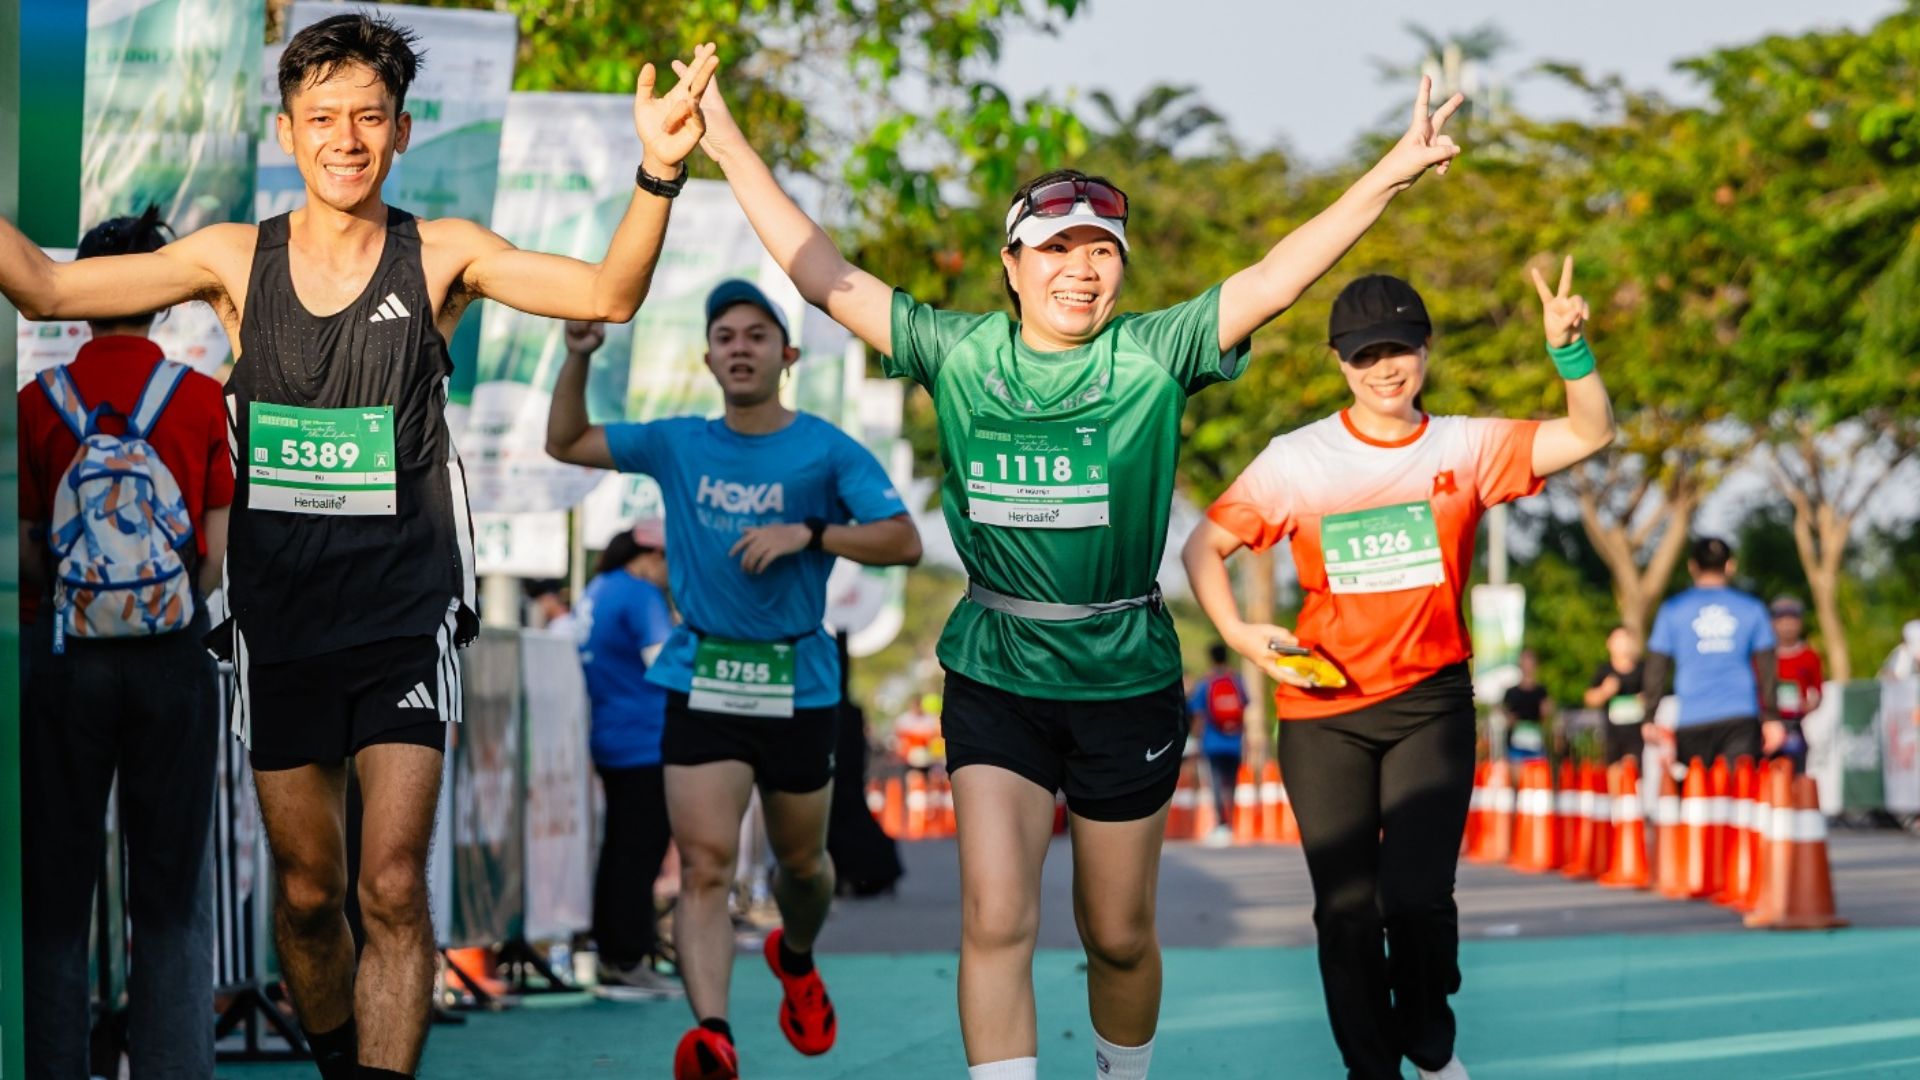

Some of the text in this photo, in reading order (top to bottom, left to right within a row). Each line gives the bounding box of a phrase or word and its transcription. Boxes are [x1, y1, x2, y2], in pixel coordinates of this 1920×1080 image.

[281, 439, 360, 469] 5389
[996, 453, 1073, 482] 1118
[294, 496, 343, 510] Herbalife
[696, 474, 785, 515] HOKA
[1008, 511, 1056, 524] Herbalife
[1347, 529, 1413, 560] 1326
[715, 658, 771, 684] 5755
